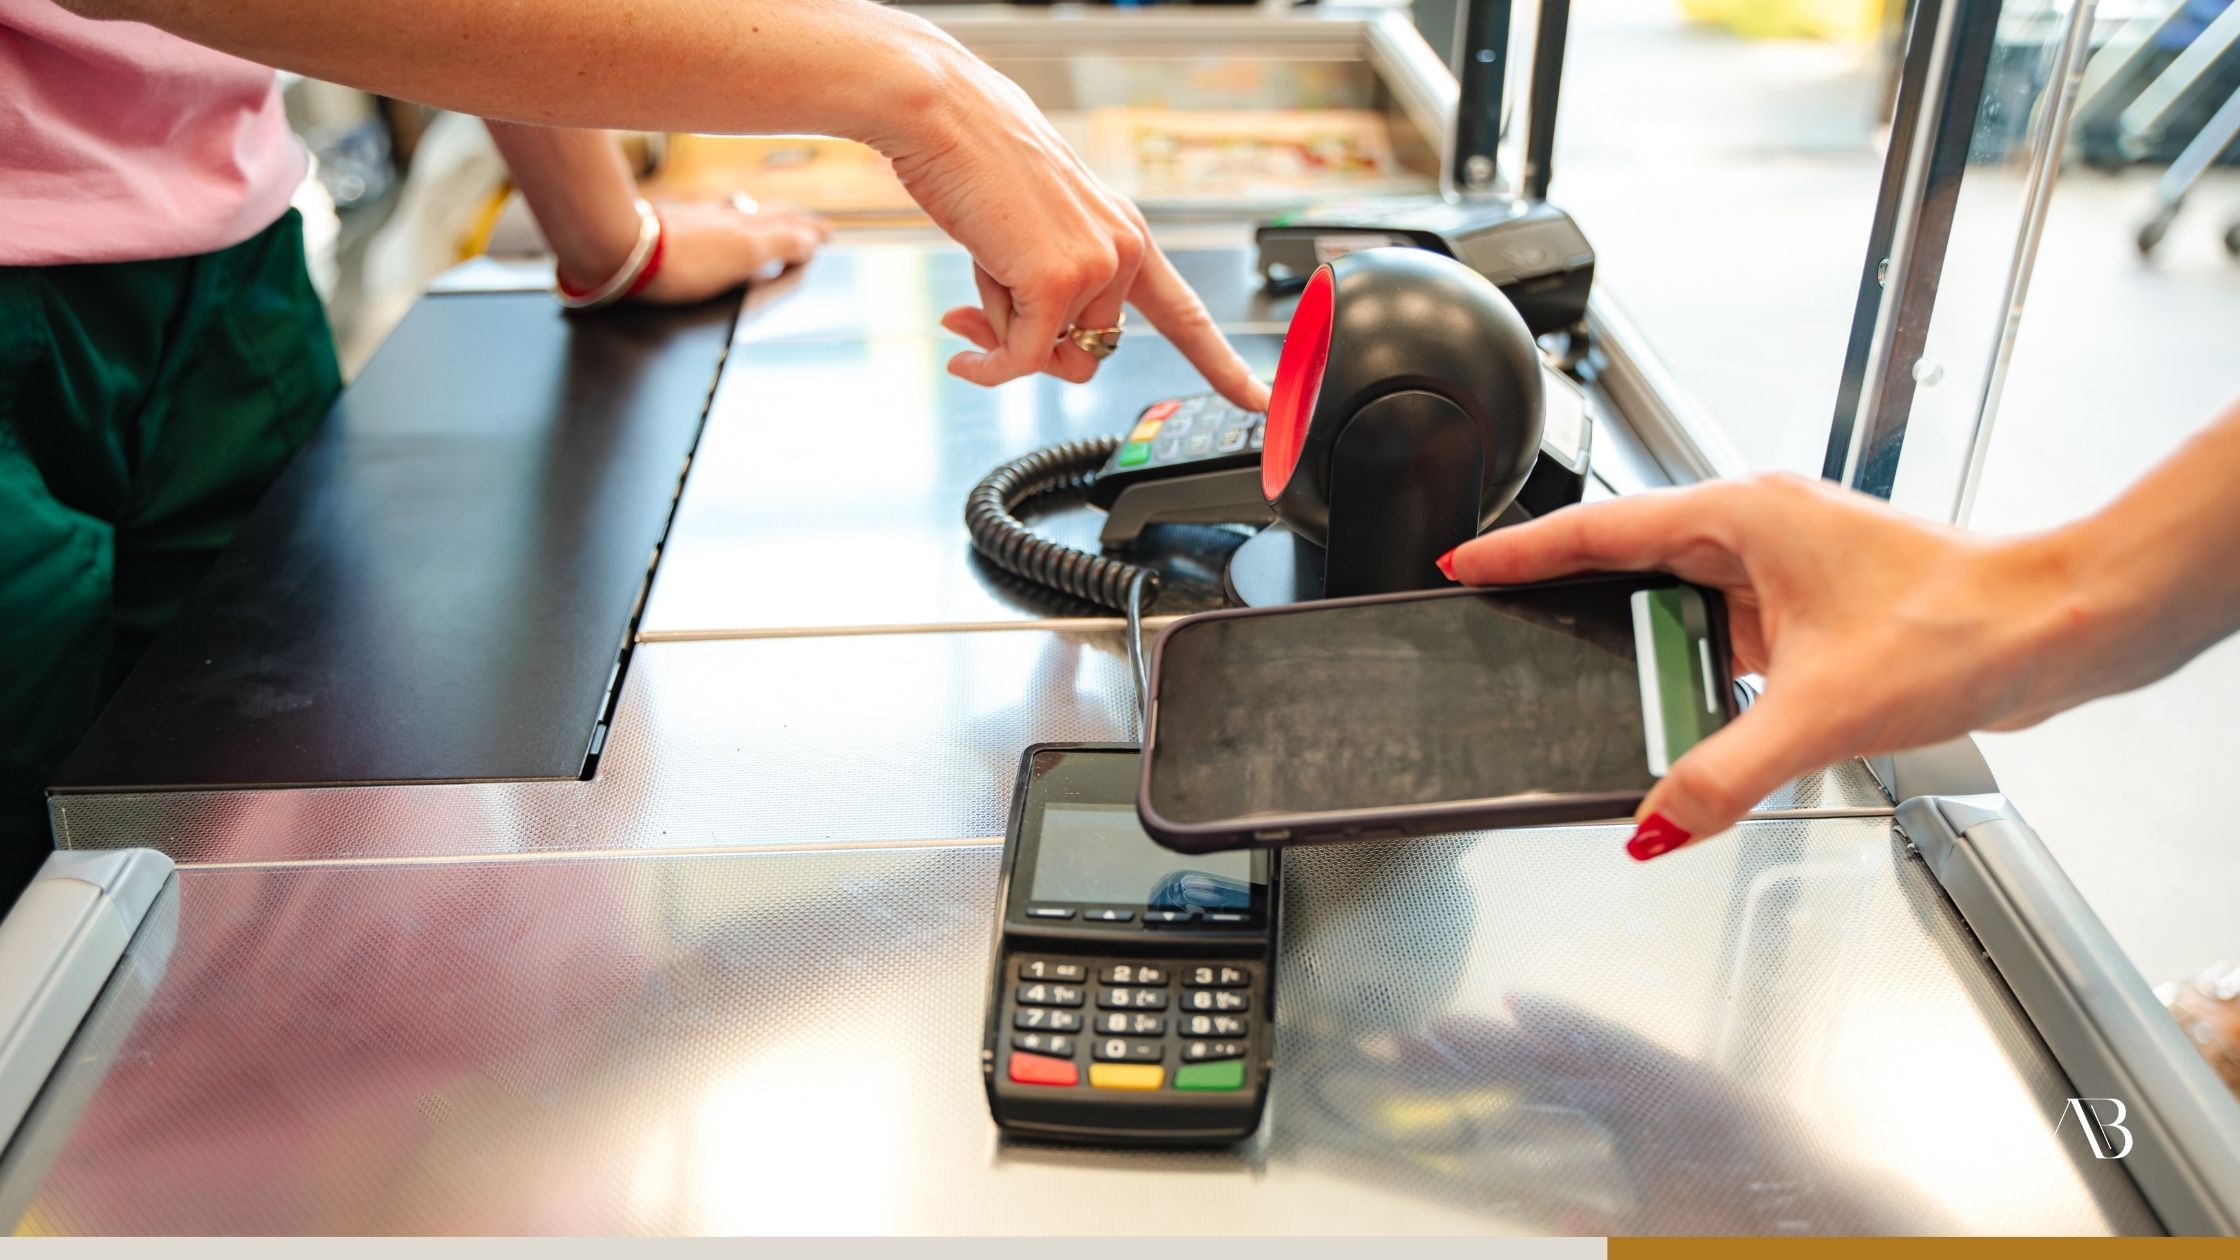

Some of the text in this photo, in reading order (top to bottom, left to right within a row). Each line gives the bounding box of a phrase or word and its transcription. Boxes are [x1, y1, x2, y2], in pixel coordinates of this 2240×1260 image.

[1031, 961, 1044, 977] 1
[1113, 965, 1131, 982] 2
[1195, 967, 1213, 984] 3
[1027, 985, 1046, 1001] 4
[1111, 988, 1129, 1005] 5
[1194, 991, 1212, 1009] 6
[1026, 1008, 1044, 1026] 7
[1108, 1013, 1127, 1031] 8
[1192, 1016, 1210, 1033] 9
